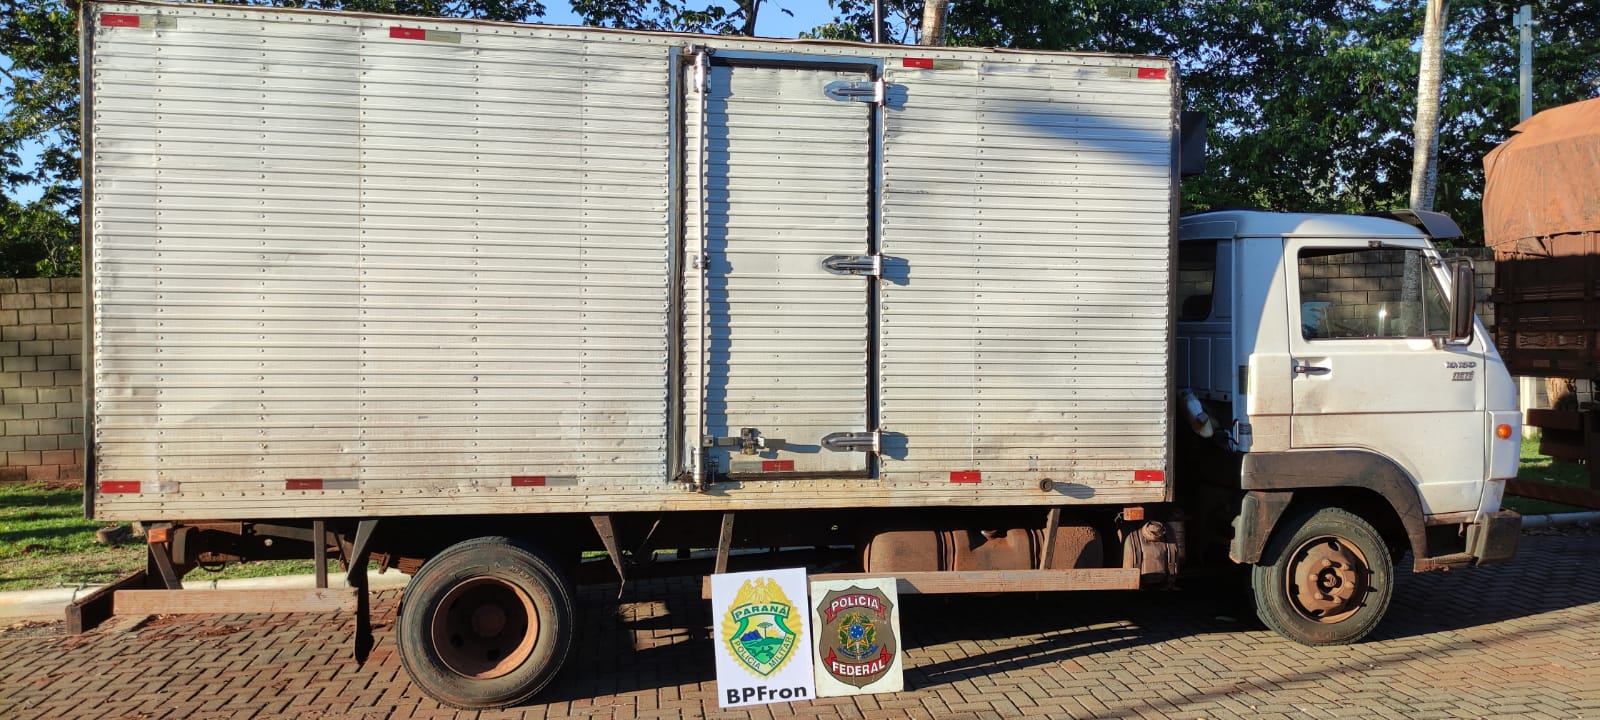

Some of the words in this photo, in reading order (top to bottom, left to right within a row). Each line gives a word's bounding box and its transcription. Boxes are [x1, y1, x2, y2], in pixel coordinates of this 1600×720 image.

[768, 636, 793, 668] MILITAR
[831, 660, 886, 677] FEDERAL
[726, 685, 807, 705] BPFron
